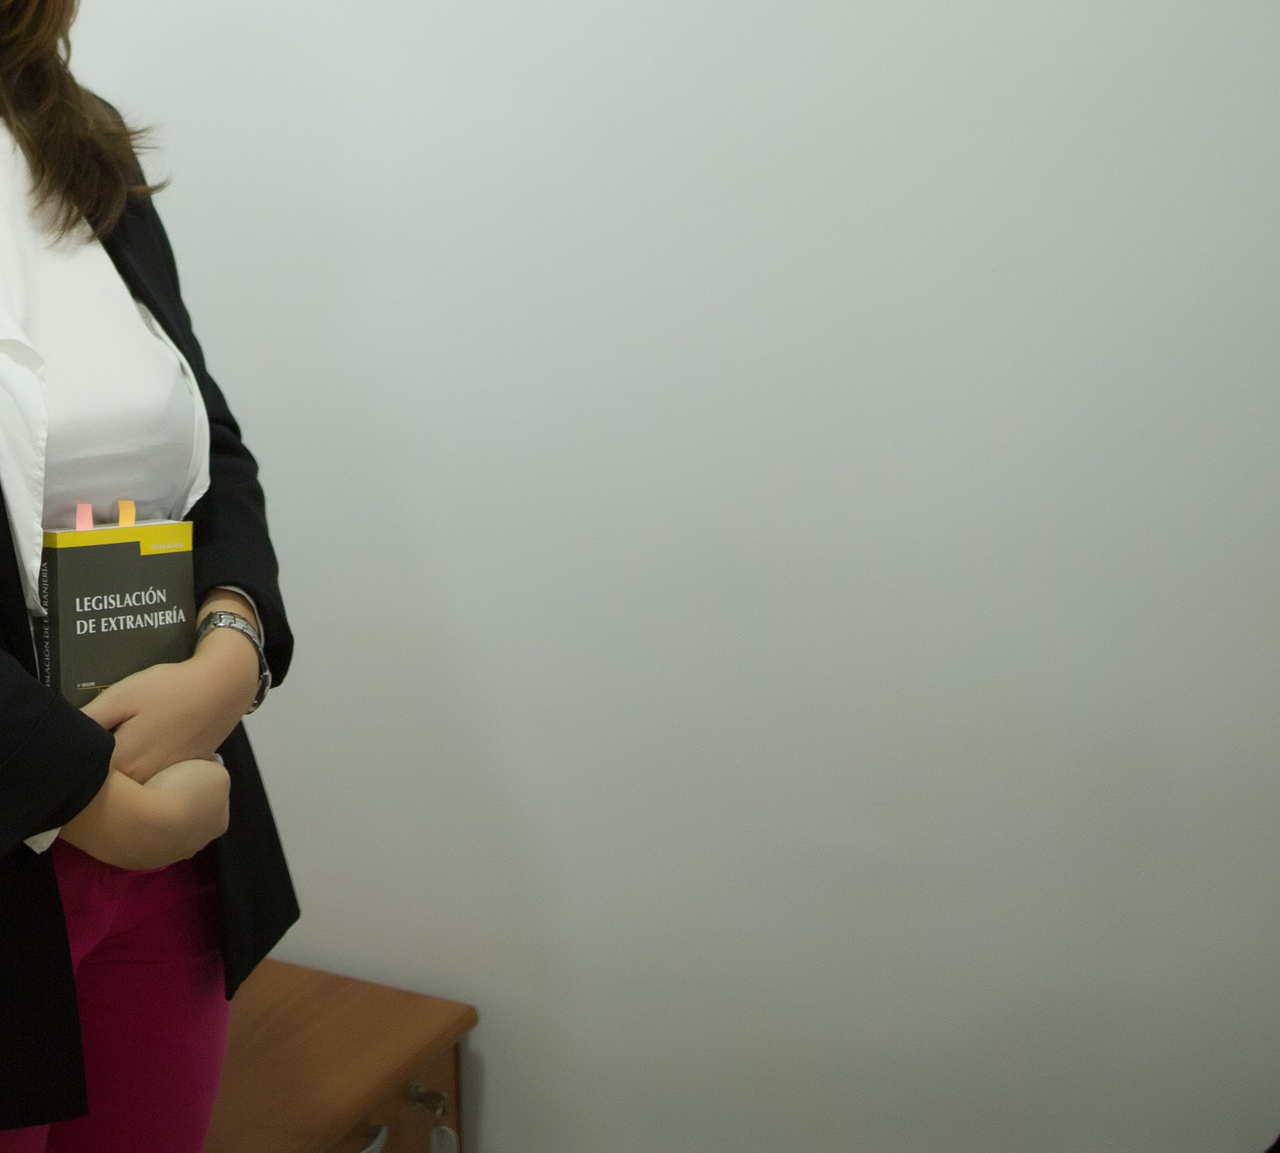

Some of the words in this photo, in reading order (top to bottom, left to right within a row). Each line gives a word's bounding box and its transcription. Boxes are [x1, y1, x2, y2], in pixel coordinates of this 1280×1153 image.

[75, 586, 167, 612] LEGISLACIÓN
[76, 619, 96, 635] DE
[101, 605, 186, 632] EXTRANJERÍA
